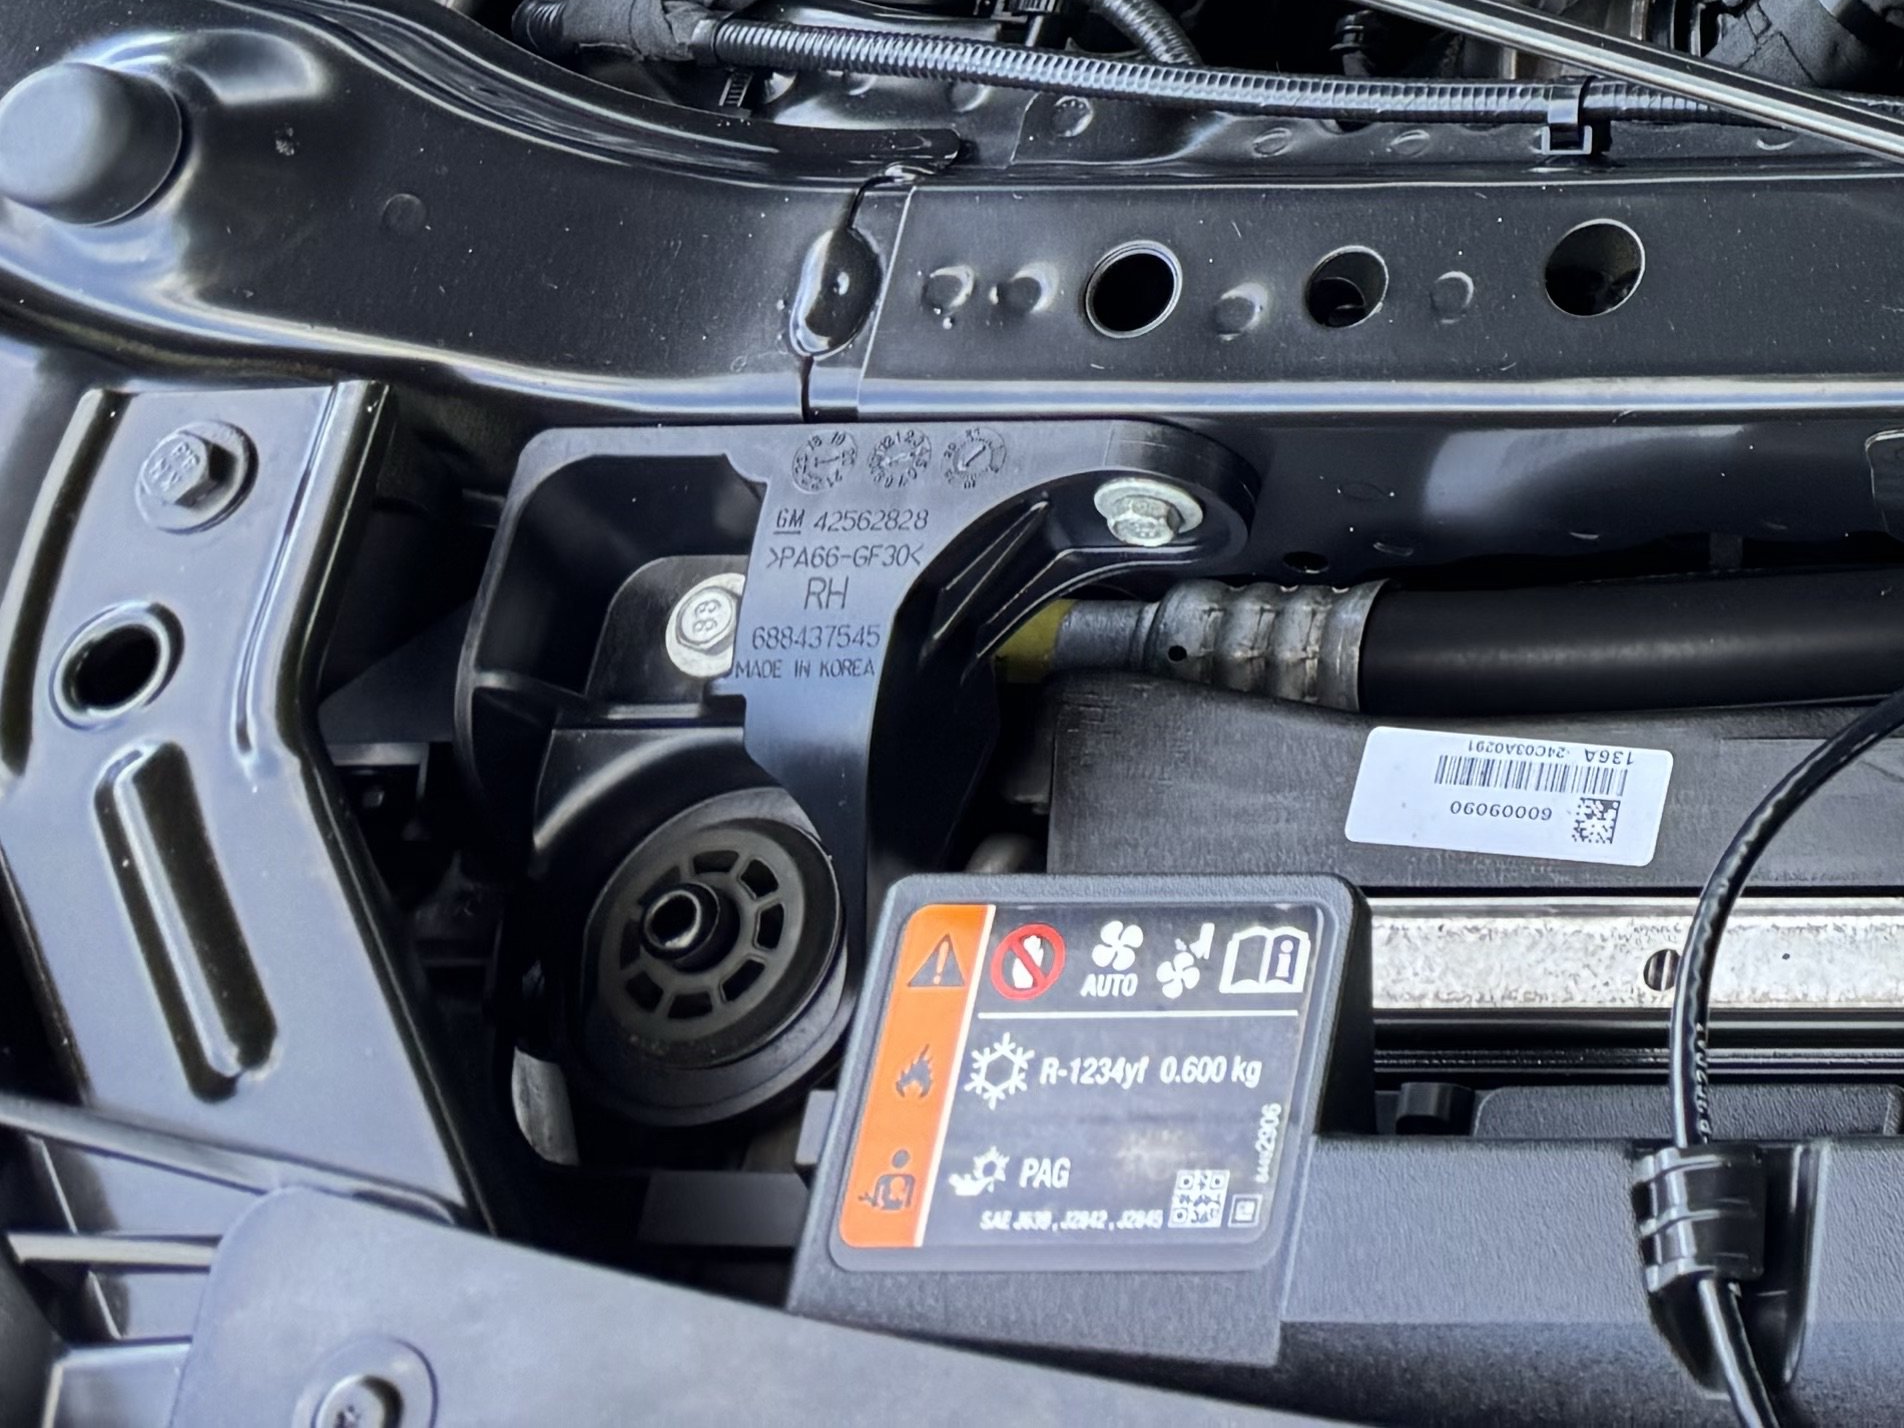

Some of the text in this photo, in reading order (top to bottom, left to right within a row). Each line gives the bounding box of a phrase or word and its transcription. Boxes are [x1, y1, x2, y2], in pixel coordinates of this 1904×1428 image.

[774, 507, 930, 534] GM 42562828
[803, 576, 850, 611] RH
[751, 622, 882, 651] 688437545
[734, 658, 876, 680] MADE IN KOREA
[1584, 747, 1635, 766] 136A
[1449, 800, 1553, 822] 60009090
[1080, 973, 1139, 998] AUTO
[1039, 1055, 1263, 1090] R-1234yf 0.600 kg
[1018, 1157, 1071, 1188] PAG
